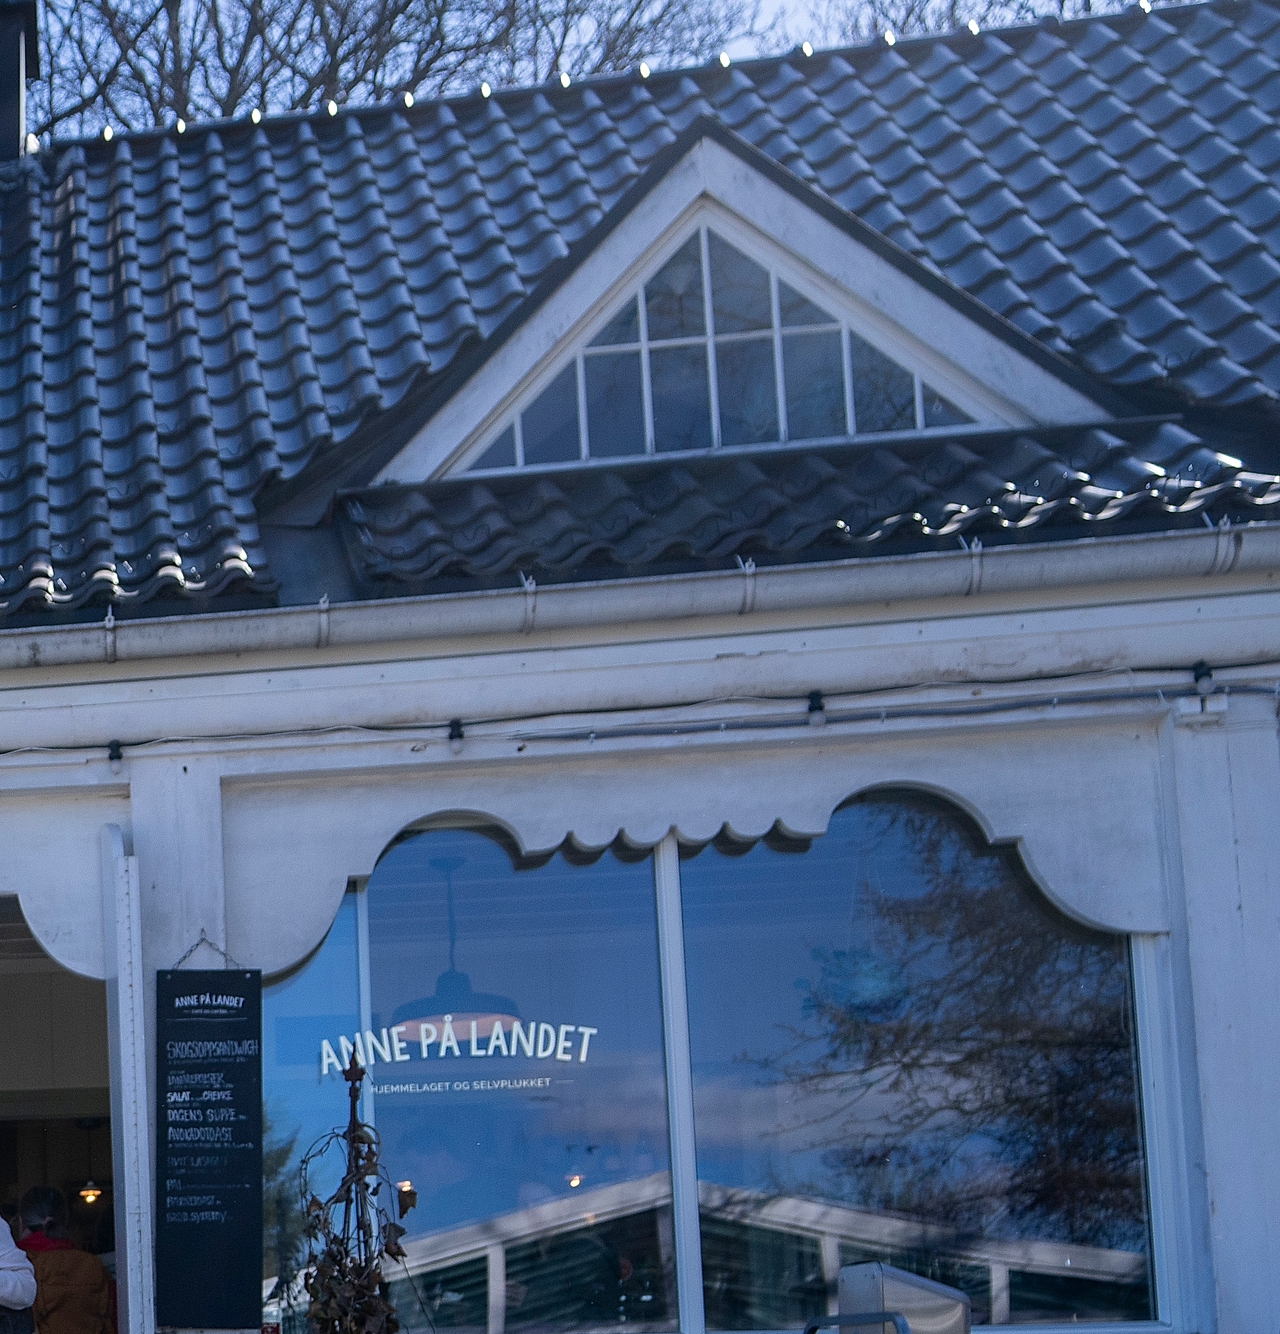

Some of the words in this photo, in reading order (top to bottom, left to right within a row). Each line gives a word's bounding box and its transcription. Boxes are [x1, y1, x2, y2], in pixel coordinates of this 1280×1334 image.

[174, 994, 199, 1009] ANNE
[199, 991, 211, 1006] PÅ
[212, 994, 245, 1009] LANDET
[321, 1025, 411, 1075] ANNE
[418, 1014, 461, 1060] PÅ
[469, 1020, 598, 1064] LANDET
[371, 1081, 450, 1095] HJEMMELAGET
[453, 1080, 470, 1091] OG
[472, 1077, 552, 1091] SELVPLUKKET
[166, 1090, 191, 1103] SALAT
[167, 1108, 203, 1122] DAGENS
